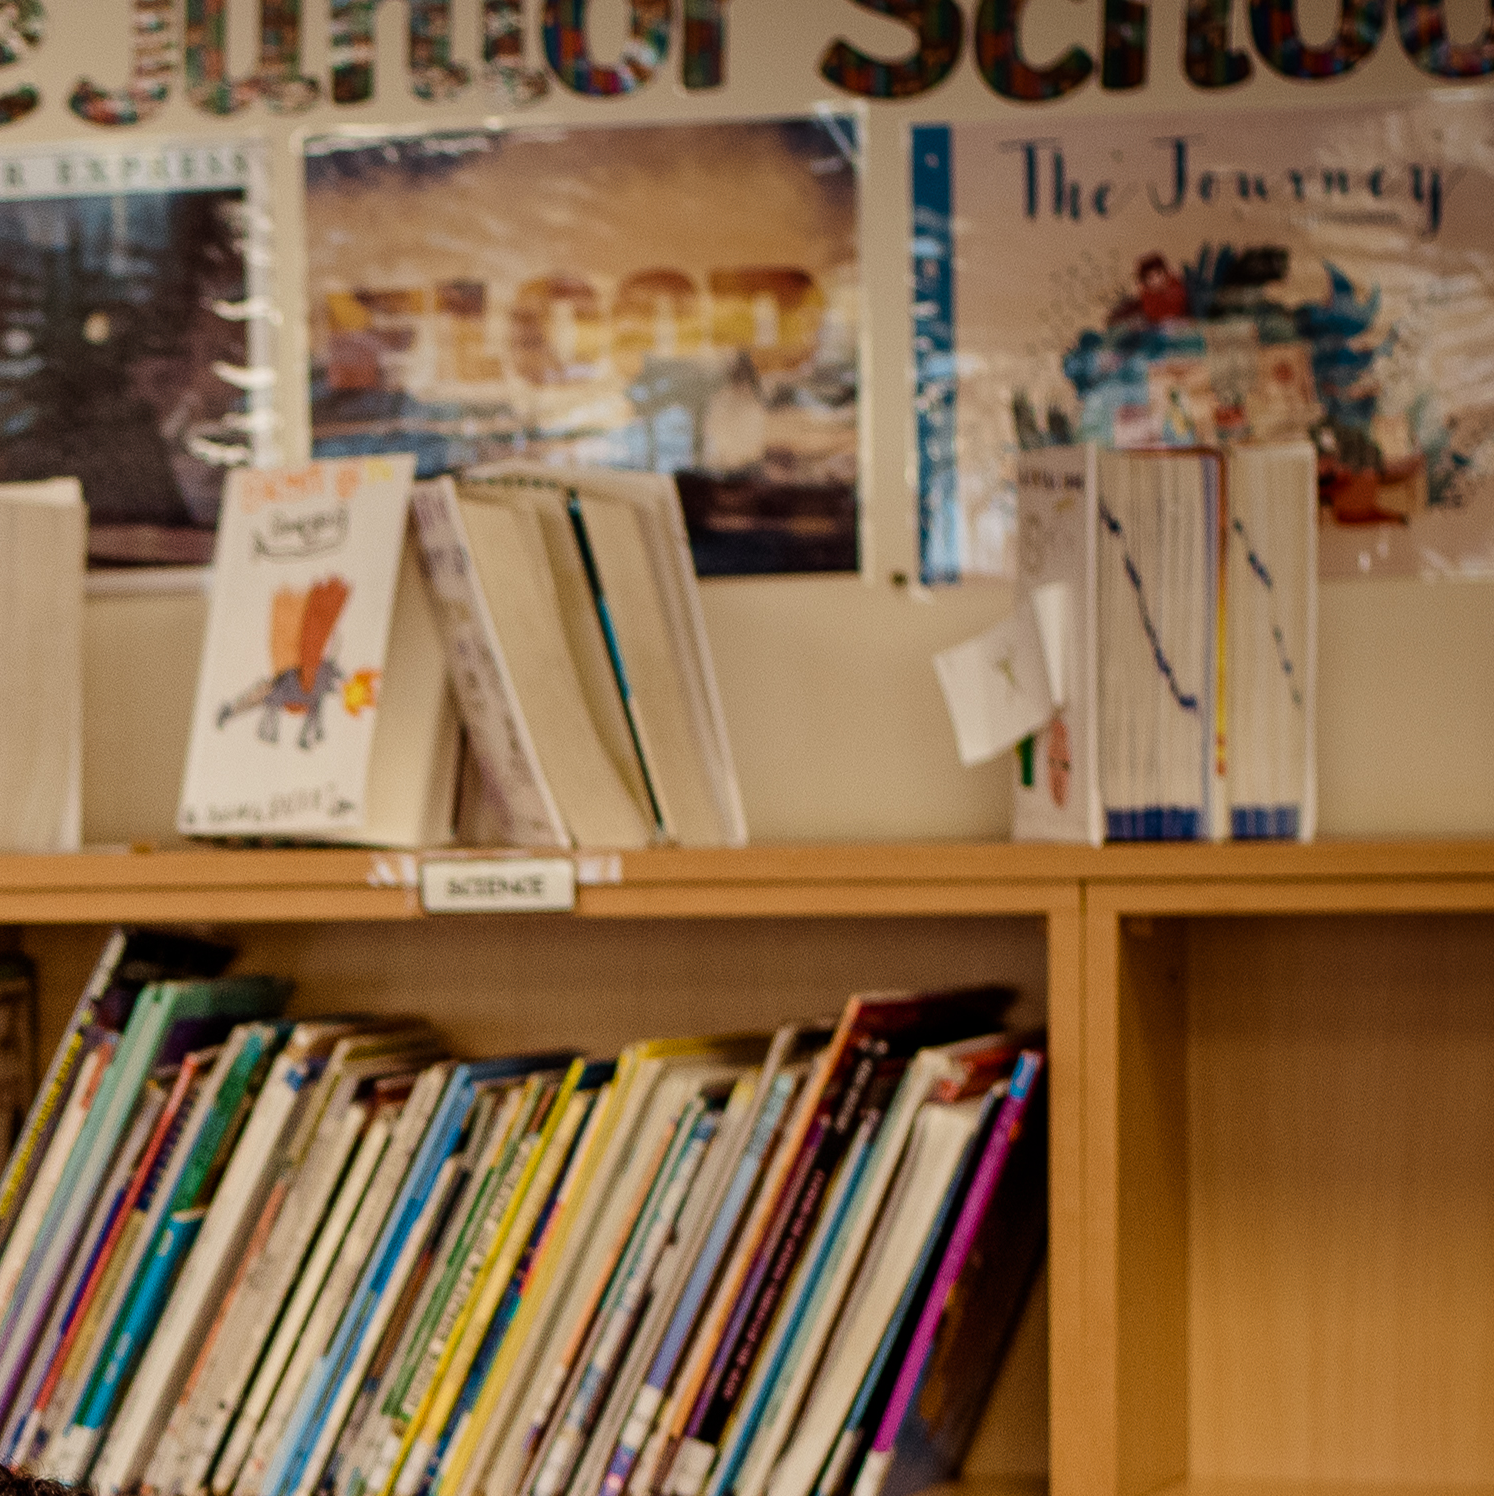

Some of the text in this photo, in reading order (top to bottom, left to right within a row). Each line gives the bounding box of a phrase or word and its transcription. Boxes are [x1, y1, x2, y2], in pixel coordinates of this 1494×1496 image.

[53, 149, 252, 189] EXPRESS
[999, 132, 1447, 237] The Journey
[446, 875, 545, 897] SCIENCE
